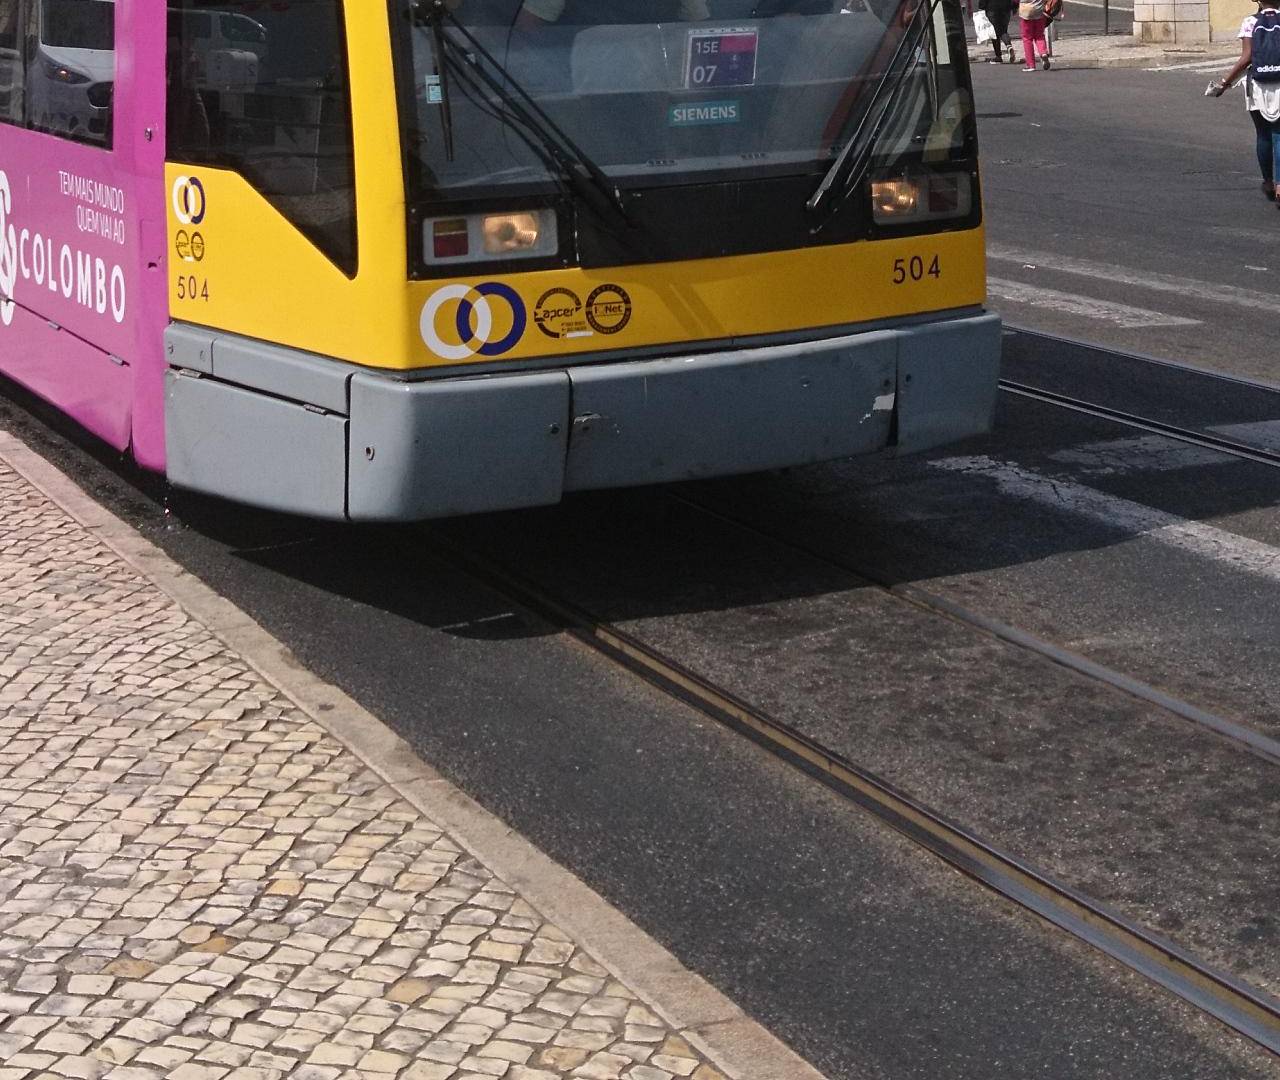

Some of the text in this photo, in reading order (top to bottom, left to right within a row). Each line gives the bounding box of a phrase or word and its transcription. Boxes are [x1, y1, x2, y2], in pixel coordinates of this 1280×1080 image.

[695, 41, 719, 55] 15E
[692, 65, 718, 84] 07
[672, 105, 737, 122] SIEMENS
[58, 170, 124, 214] TEM MAIS MUNDO
[77, 204, 125, 245] QUEM VAI AO
[20, 228, 125, 323] COLOMBO
[892, 253, 942, 284] 504
[176, 274, 209, 302] 504
[543, 307, 575, 322] apcer
